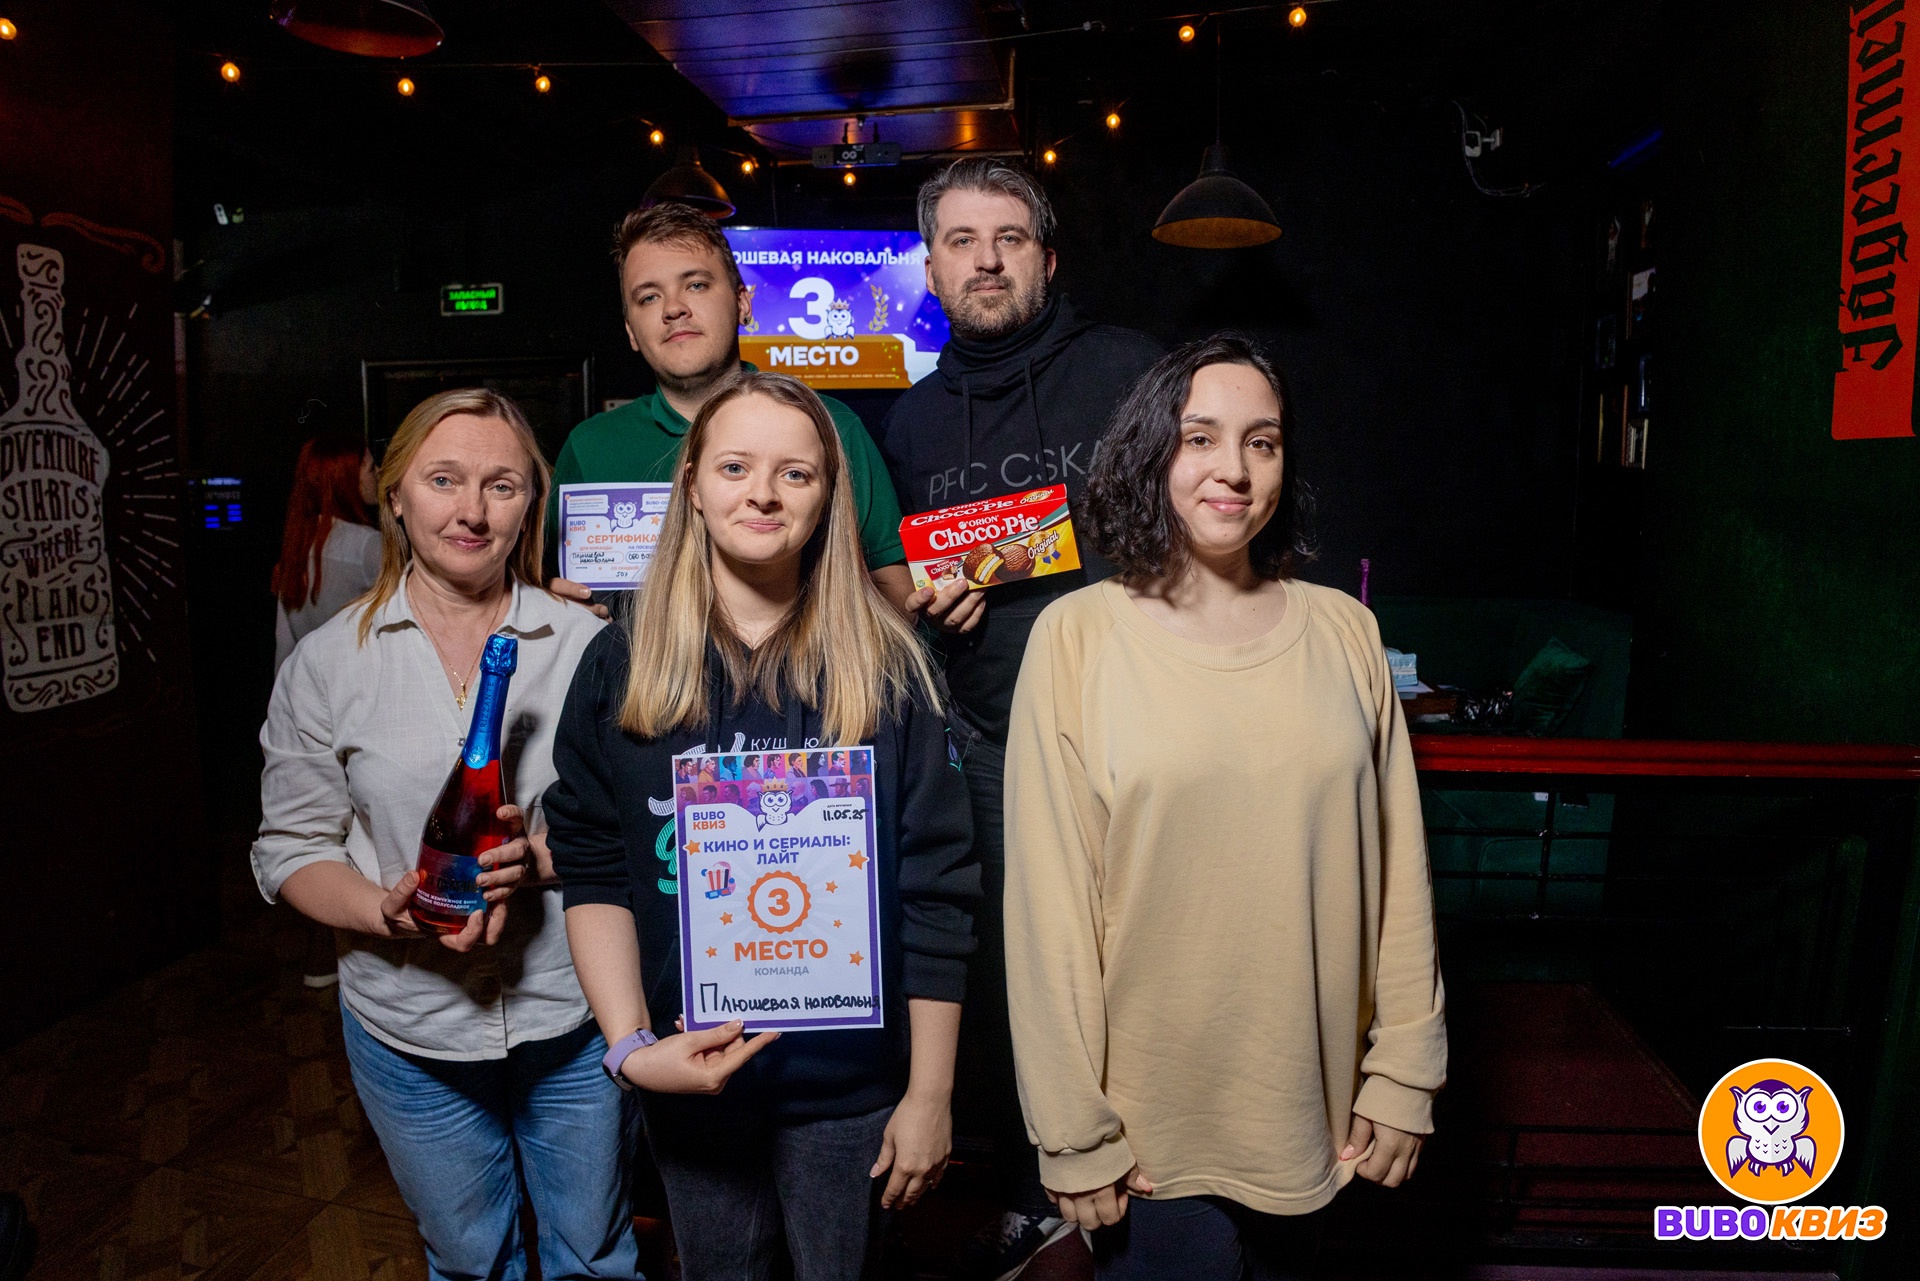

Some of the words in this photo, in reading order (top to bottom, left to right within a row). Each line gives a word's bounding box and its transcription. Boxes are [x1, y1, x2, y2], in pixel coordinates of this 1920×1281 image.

[1838, 0, 1909, 372] Jägermei
[807, 250, 921, 266] НАКОВАЛЬНЯ
[788, 277, 835, 341] 3
[770, 344, 860, 367] МЕСТО
[928, 461, 988, 506] PFC
[2, 479, 90, 522] STARTS
[569, 519, 587, 527] BUBO
[966, 515, 998, 527] ORION
[586, 533, 660, 545] СЕРТИФИКА
[1027, 530, 1059, 560] Original
[19, 524, 84, 579] WHERE
[15, 573, 100, 625] PLANS
[36, 622, 86, 663] END
[478, 681, 495, 735] FRIZZANTE
[692, 811, 726, 821] BUBO
[692, 820, 726, 831] КВИЗ
[823, 809, 869, 821] 11.05.25
[703, 839, 748, 853] КИНО
[753, 839, 765, 851] И
[768, 835, 851, 850] СЕРИАЛЫ:
[756, 850, 799, 865] ЛАЙТ
[767, 888, 791, 917] 3
[734, 939, 828, 962] МЕСТО
[754, 965, 810, 976] КОМАНДА
[699, 982, 801, 1014] Плюшевая
[804, 994, 881, 1010] наковальня
